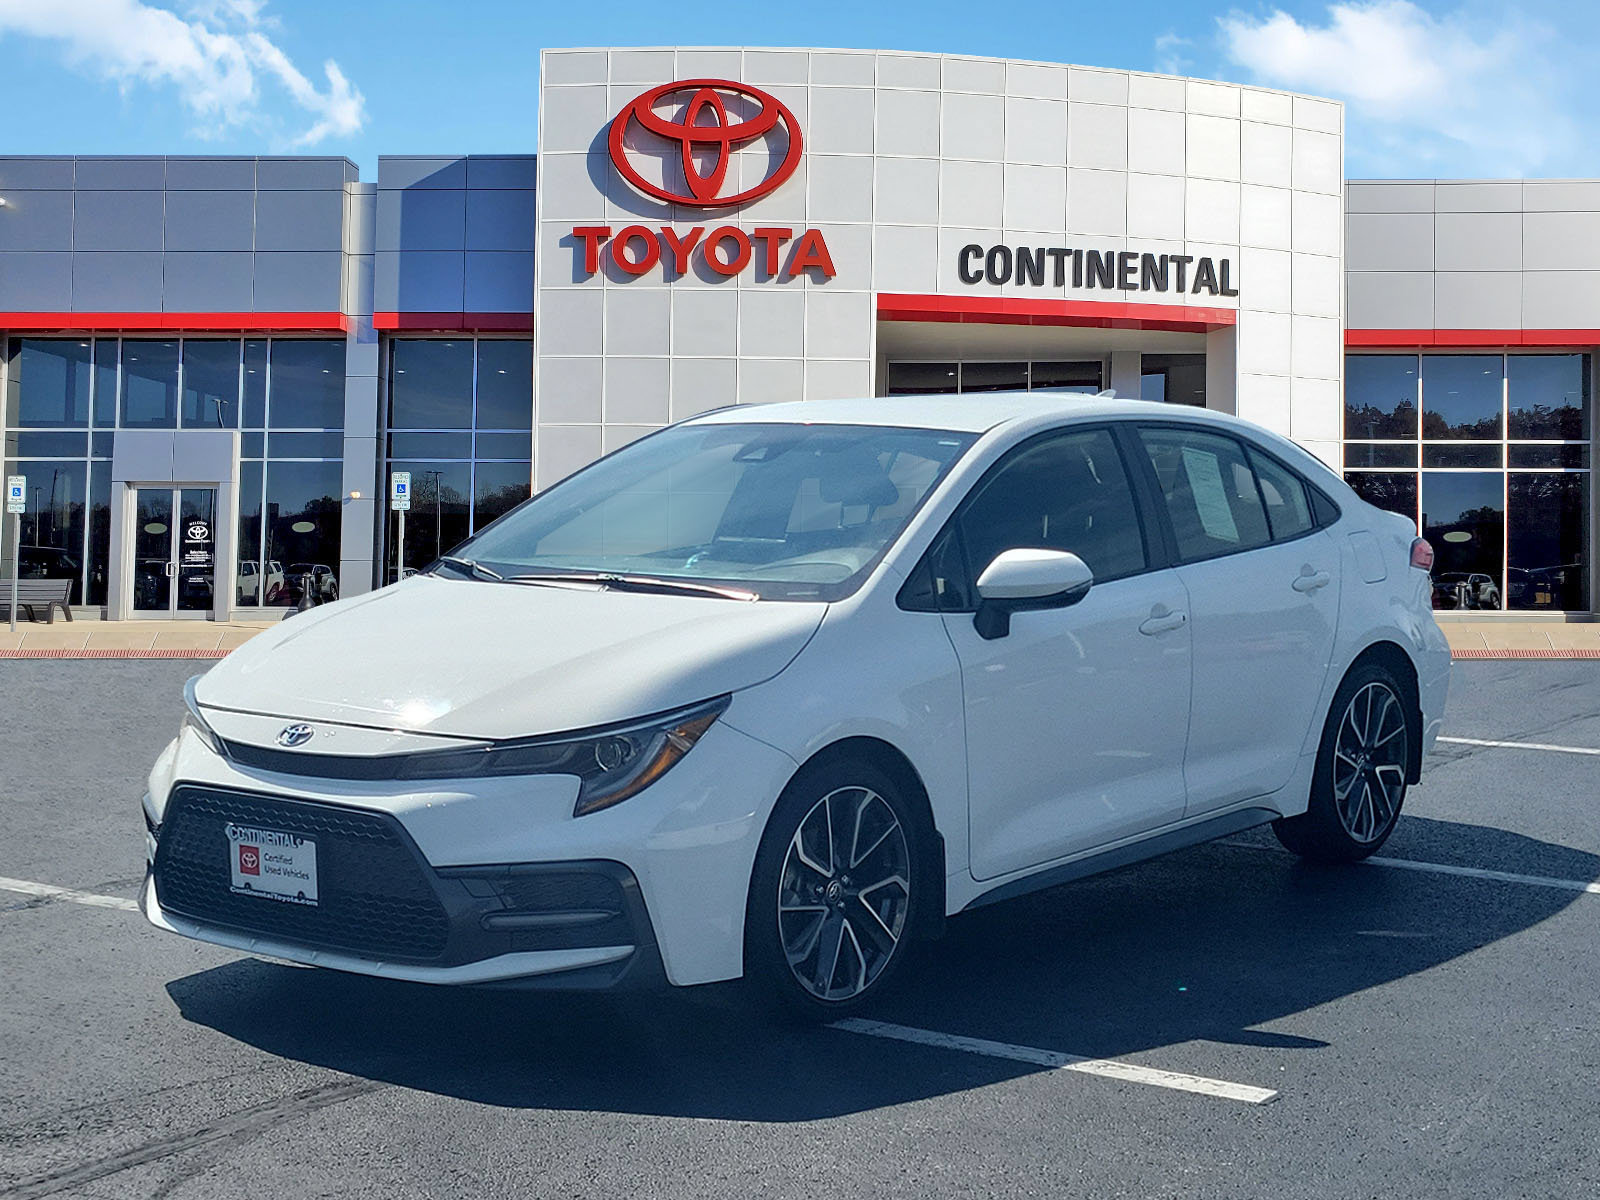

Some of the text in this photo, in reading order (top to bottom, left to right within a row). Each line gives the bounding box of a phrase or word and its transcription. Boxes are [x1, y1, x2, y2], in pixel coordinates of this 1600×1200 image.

[572, 225, 837, 277] TOYOTA
[958, 244, 1239, 297] CONTINENTAL
[263, 852, 293, 866] Certified
[264, 865, 309, 880] Used Vehicles
